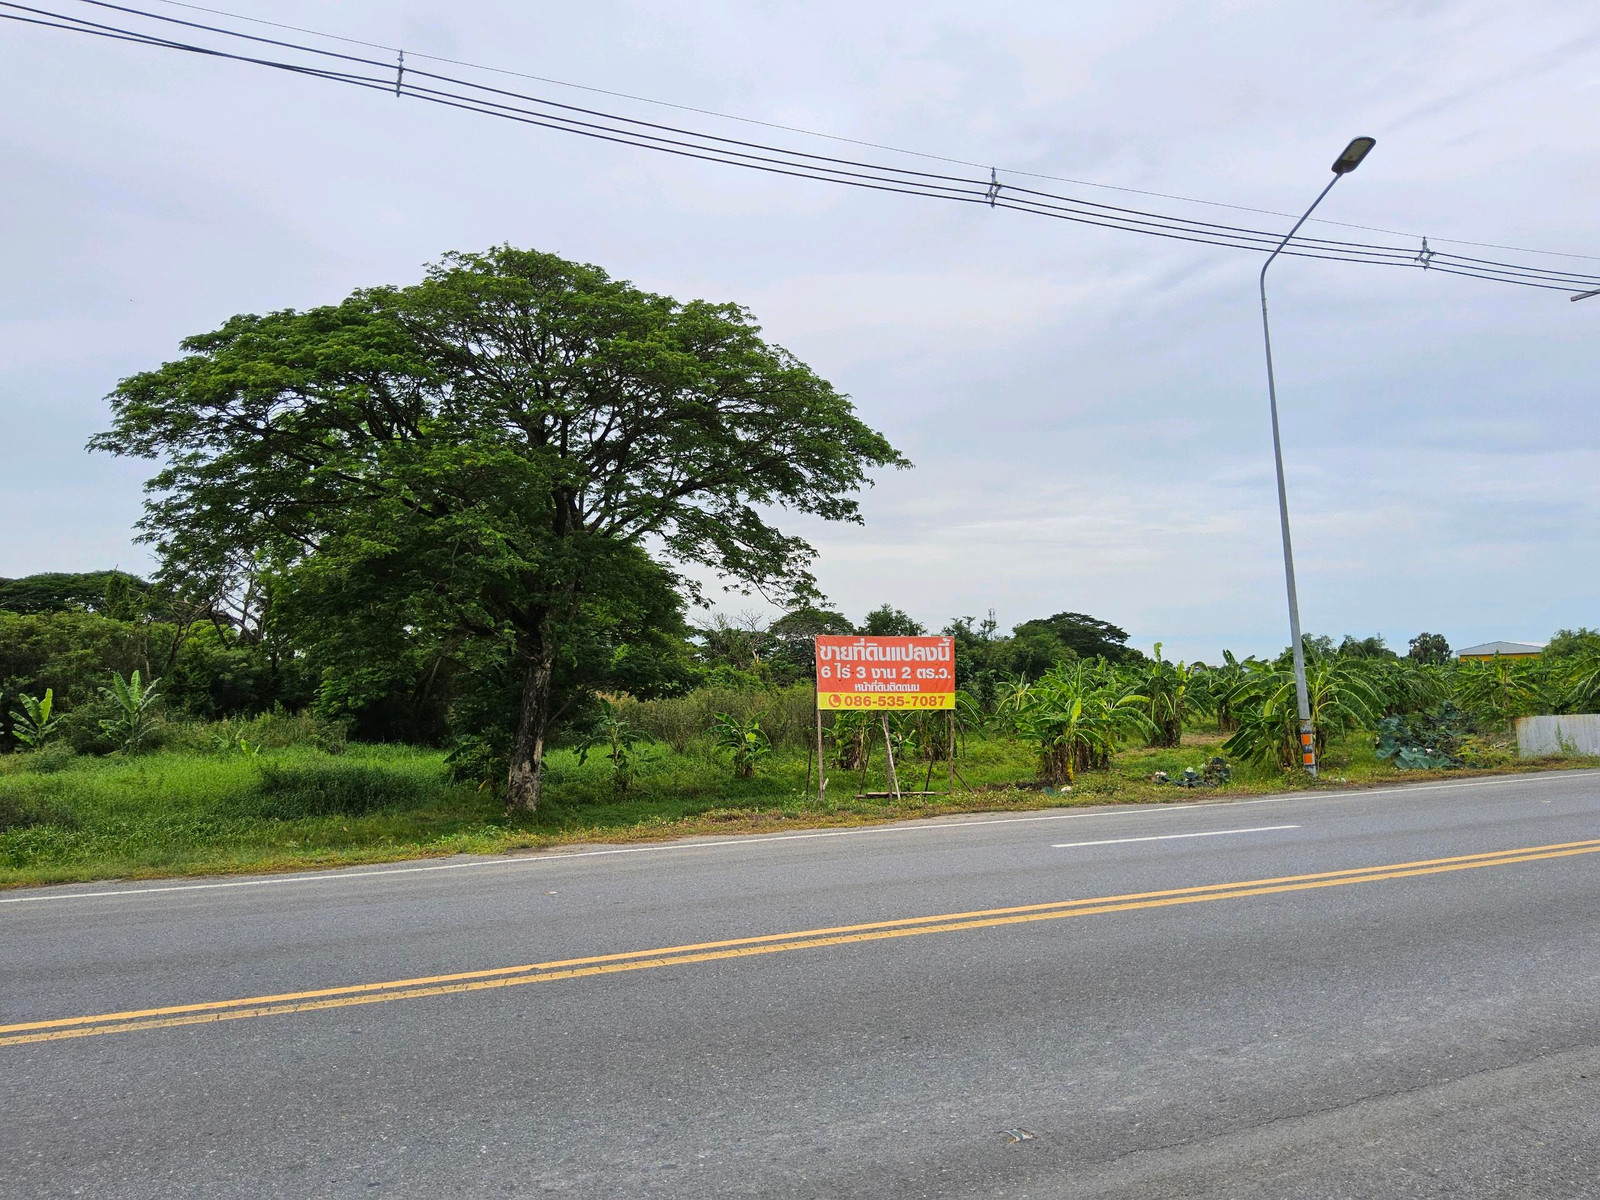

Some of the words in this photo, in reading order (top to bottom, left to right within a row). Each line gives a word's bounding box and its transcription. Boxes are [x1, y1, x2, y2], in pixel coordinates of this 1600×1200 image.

[819, 637, 951, 661] ขายที่ดินแปลงนี้
[821, 666, 831, 679] 6
[834, 662, 851, 679] ไร่
[856, 666, 866, 679] 3
[871, 667, 896, 679] งาน
[901, 666, 911, 679] 2
[916, 667, 951, 679] ตร.ว.
[854, 680, 920, 692] หน้าที่ดินติดถนน
[844, 695, 946, 707] 086-535-7087
